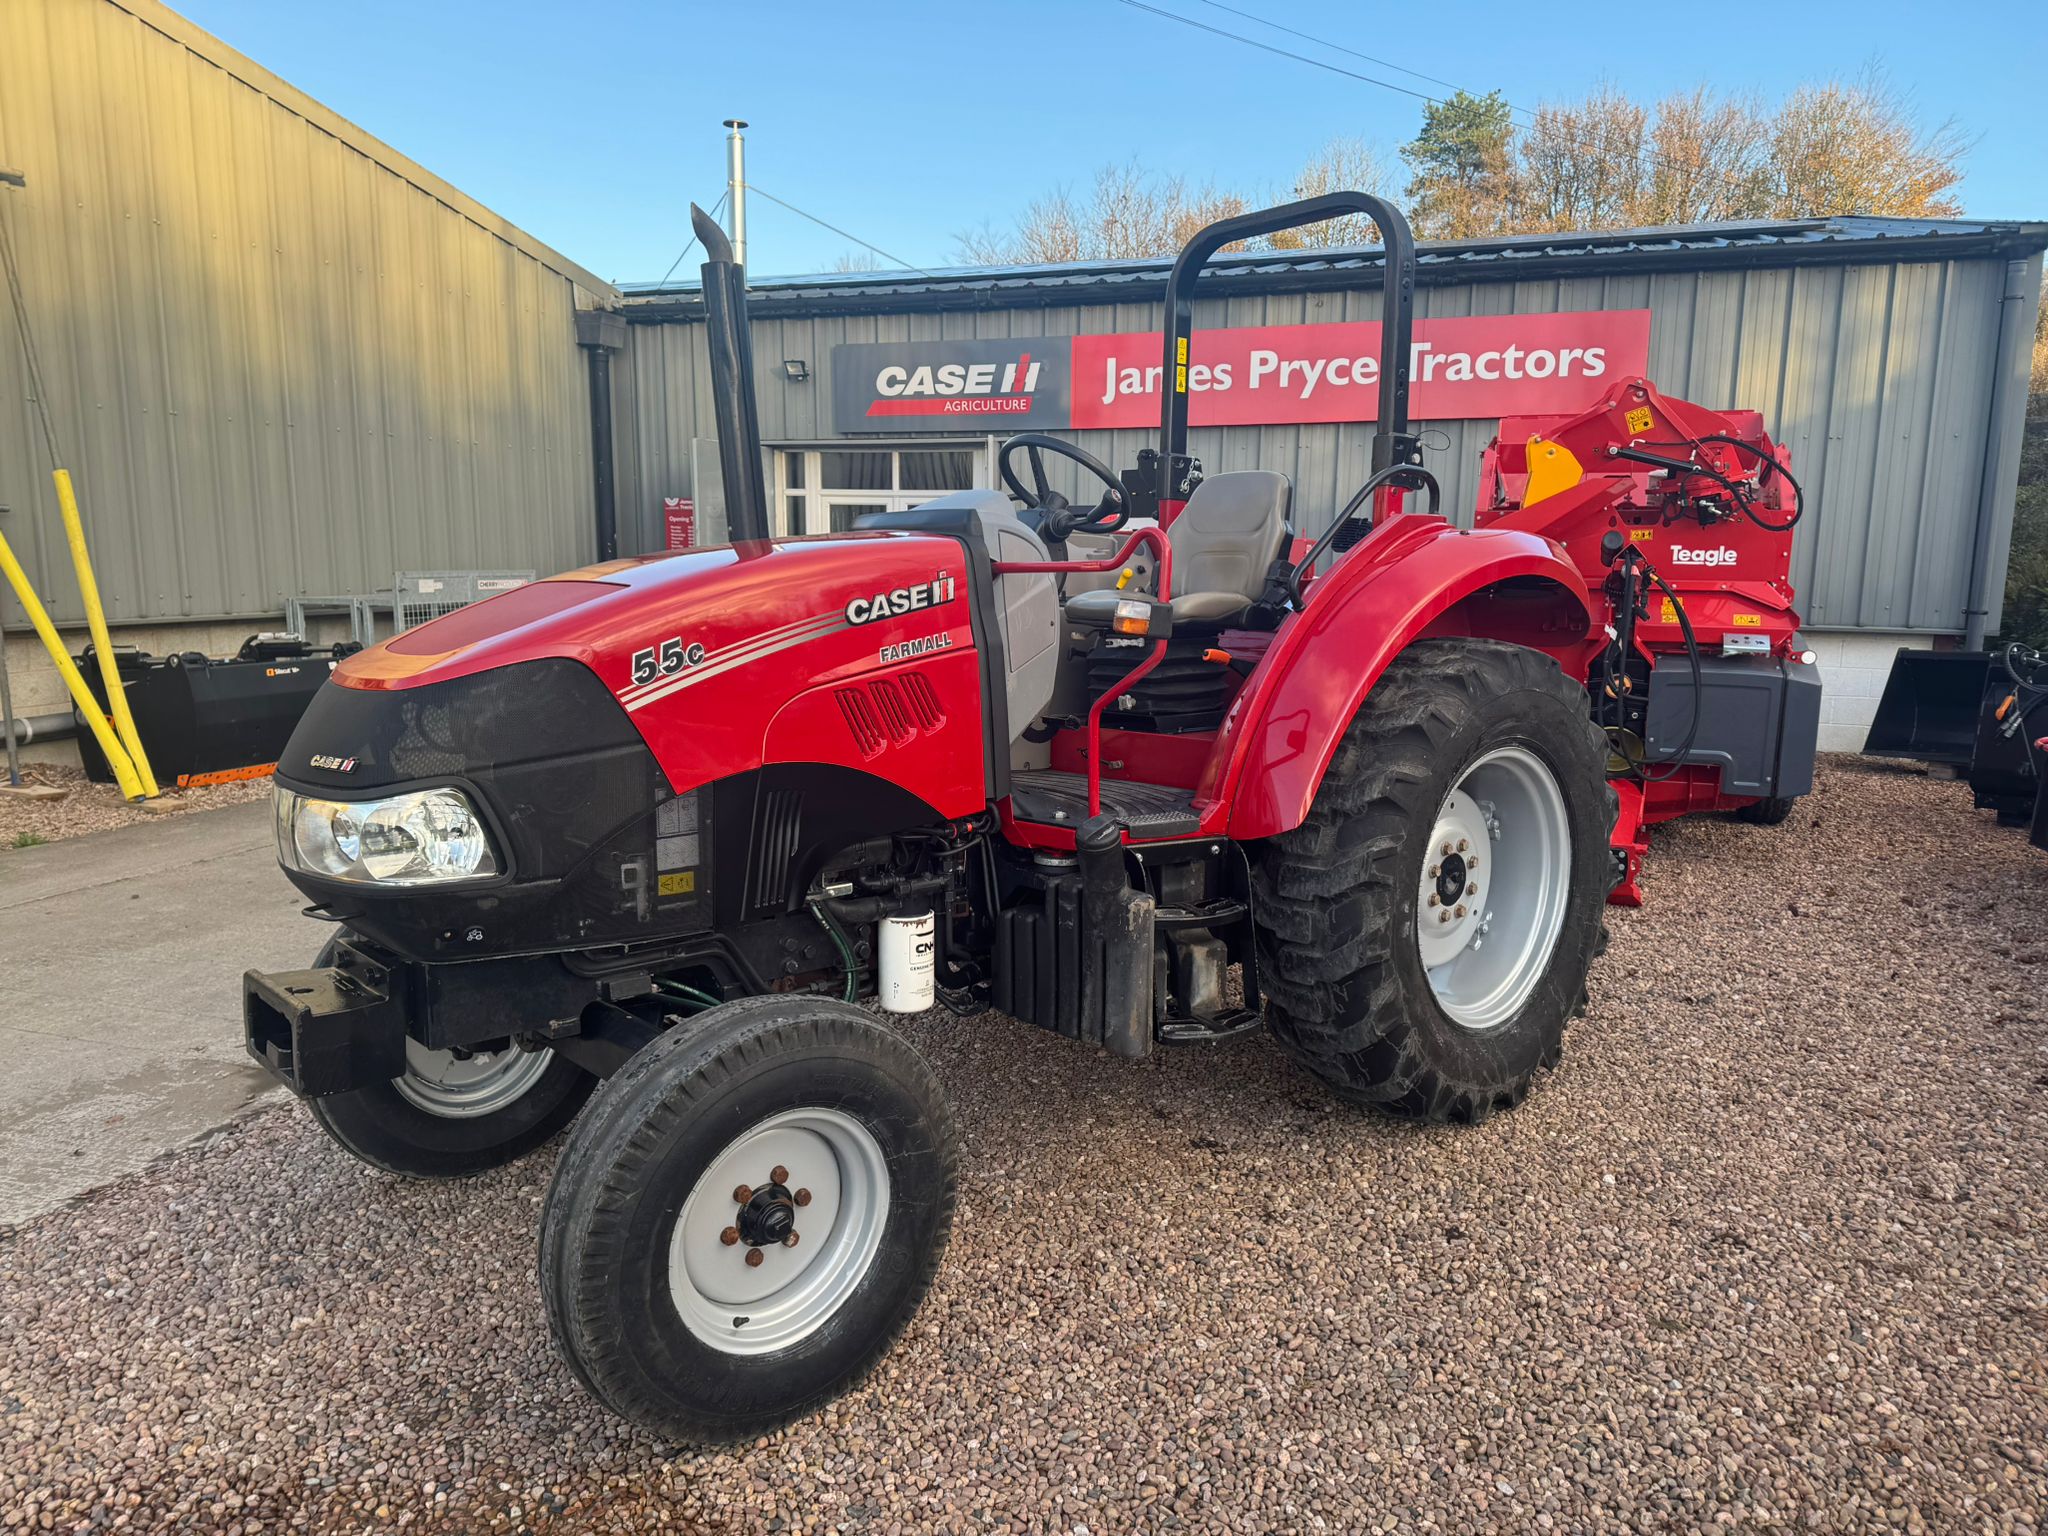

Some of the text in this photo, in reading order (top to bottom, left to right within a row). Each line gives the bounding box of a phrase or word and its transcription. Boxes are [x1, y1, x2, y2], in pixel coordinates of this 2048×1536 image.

[876, 363, 997, 397] CASE
[1249, 349, 1378, 399] Pryce
[1409, 342, 1605, 383] Tractors
[944, 398, 1027, 413] AGRICULTURE
[1670, 545, 1738, 567] Teagle
[846, 582, 929, 624] CASE
[880, 632, 952, 664] FARMALL
[310, 754, 342, 769] CASE
